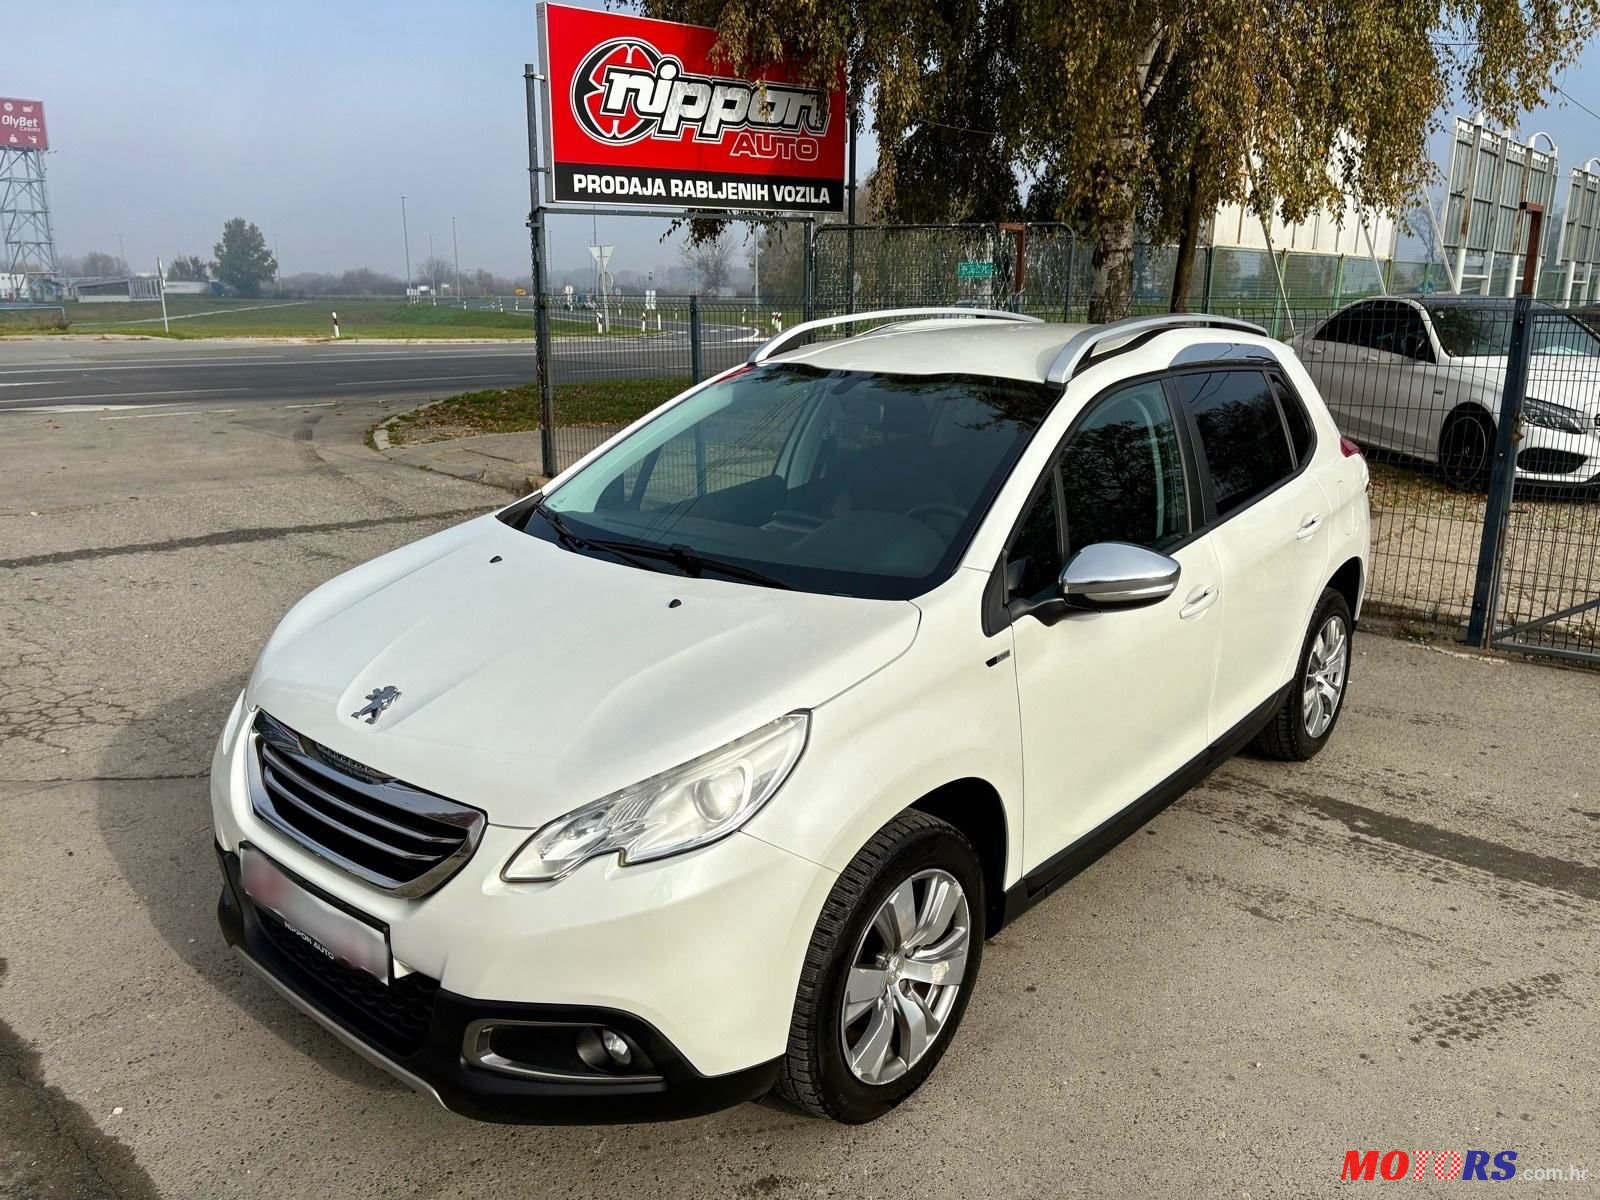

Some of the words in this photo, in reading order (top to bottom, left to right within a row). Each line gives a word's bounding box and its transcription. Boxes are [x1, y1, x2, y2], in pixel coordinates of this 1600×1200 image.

[602, 61, 828, 136] nippon
[2, 115, 38, 128] OlyBet
[730, 132, 819, 162] AUTO
[573, 173, 667, 198] PRODAJA
[670, 178, 769, 202] RABLJENIH
[773, 185, 831, 204] VOZILA
